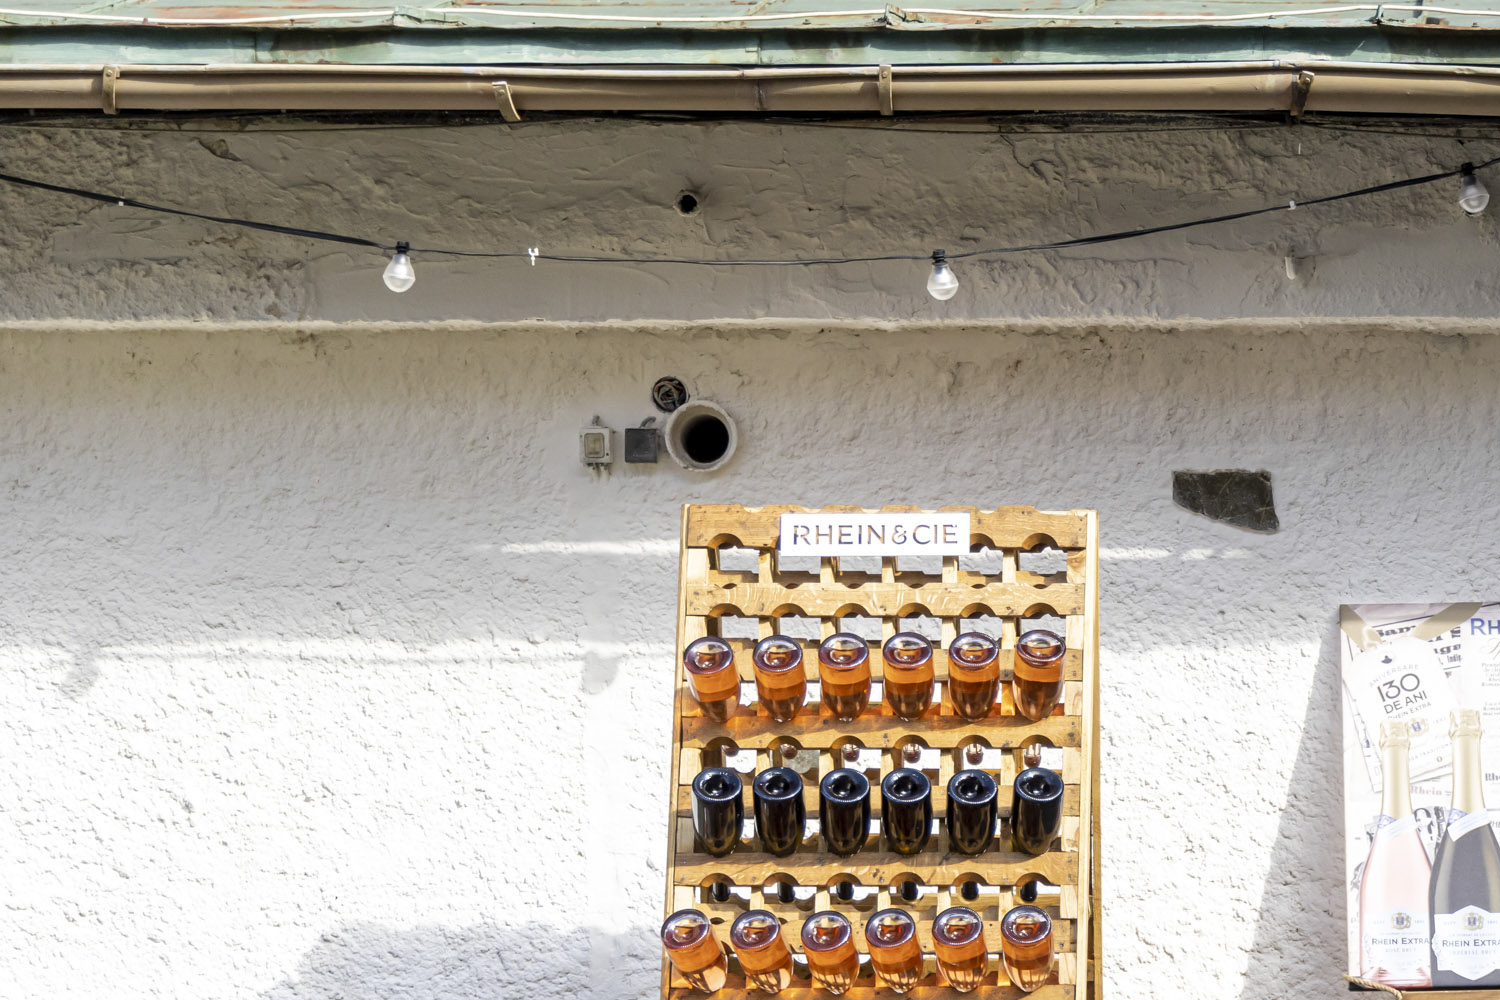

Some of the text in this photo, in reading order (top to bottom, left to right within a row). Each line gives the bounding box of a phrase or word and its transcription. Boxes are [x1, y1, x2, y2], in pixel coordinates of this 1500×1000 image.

[793, 523, 958, 545] RHEIN&CIE
[1377, 673, 1420, 702] 130
[1384, 690, 1428, 714] DE ANI
[1410, 702, 1432, 714] EXTRA
[1401, 937, 1429, 945] EXTRA
[1442, 939, 1470, 948] RHEIN
